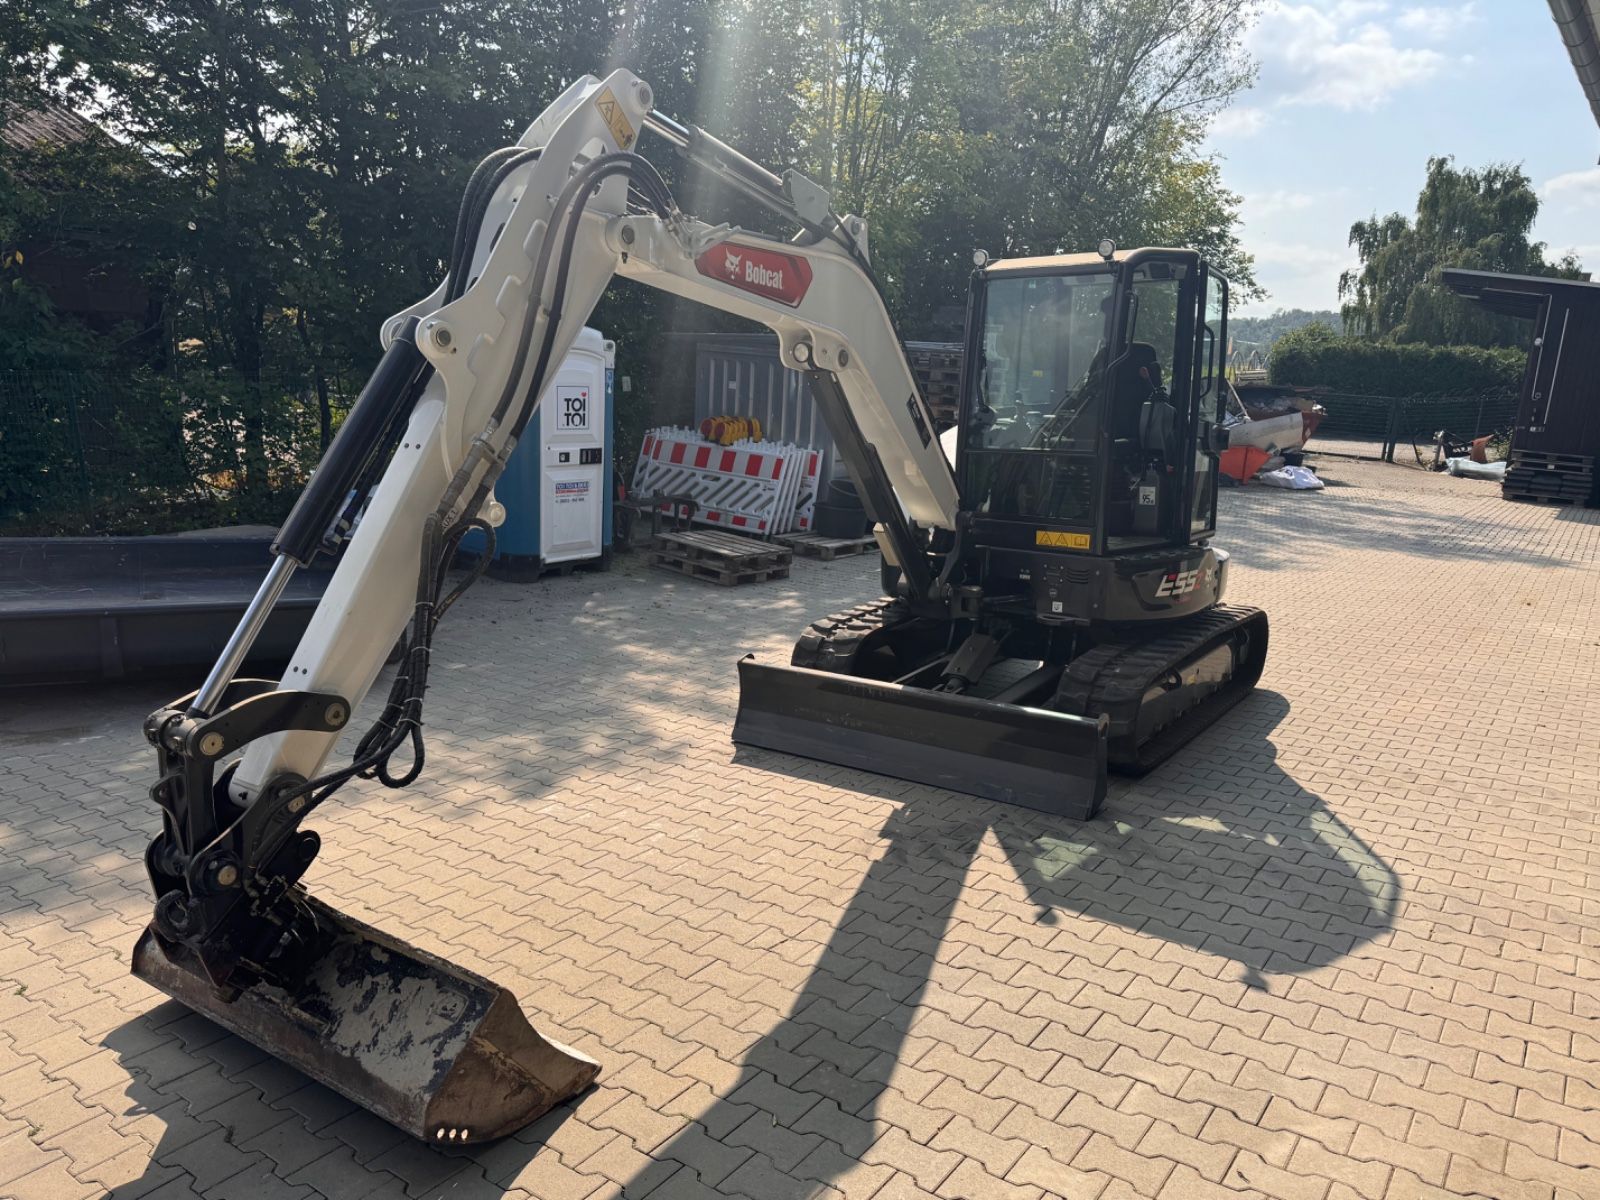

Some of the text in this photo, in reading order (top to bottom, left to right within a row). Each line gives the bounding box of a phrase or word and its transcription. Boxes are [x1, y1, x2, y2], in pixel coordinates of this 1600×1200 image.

[745, 260, 783, 290] Bobcat
[564, 398, 586, 412] TOI
[564, 413, 586, 427] TOI
